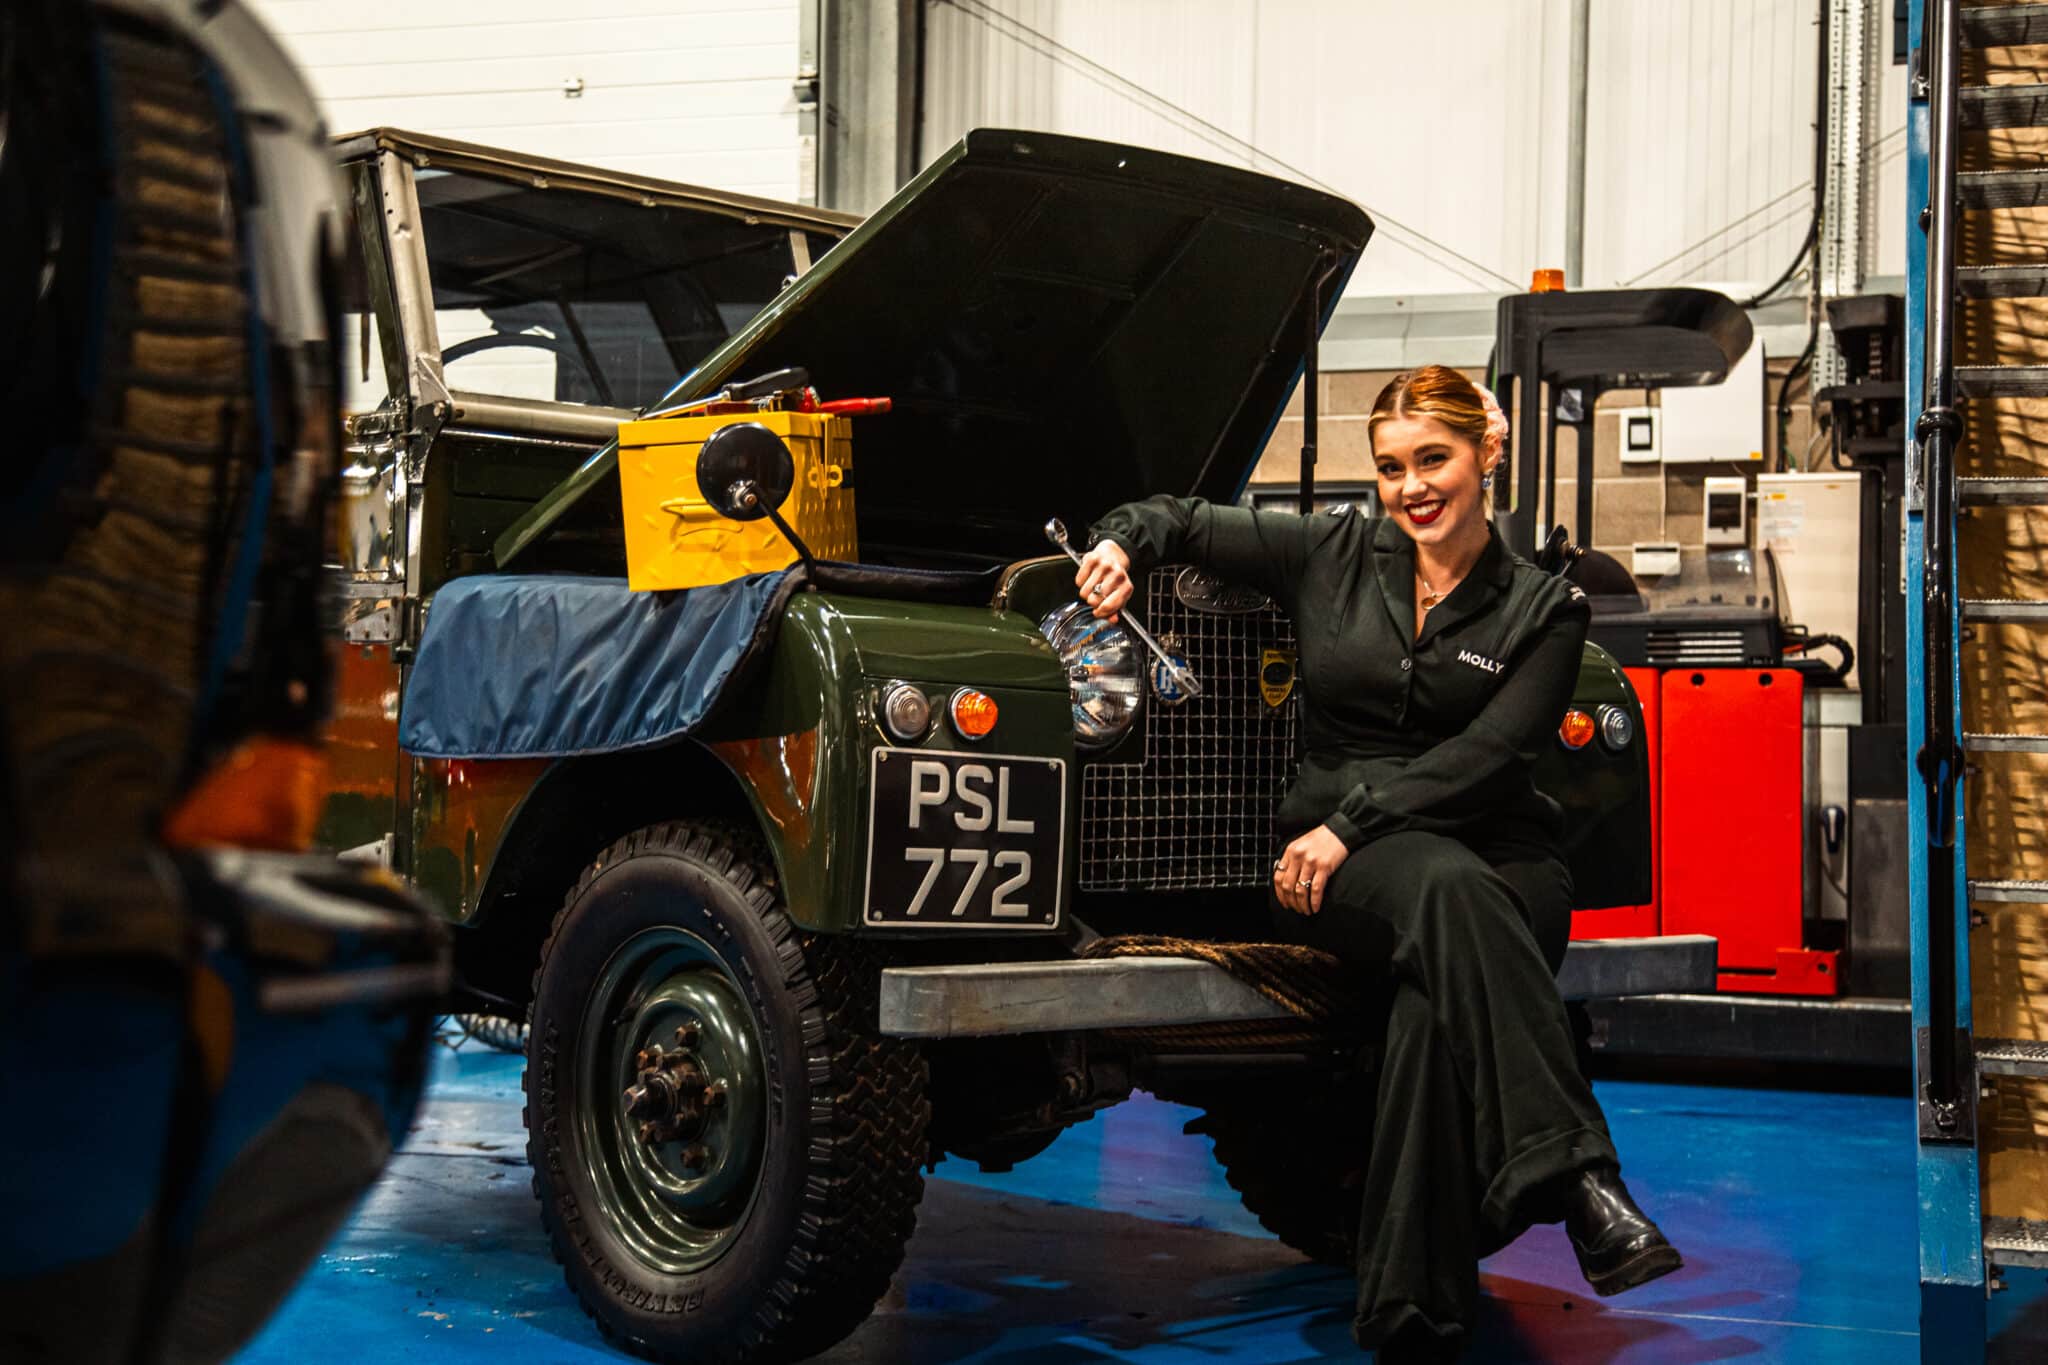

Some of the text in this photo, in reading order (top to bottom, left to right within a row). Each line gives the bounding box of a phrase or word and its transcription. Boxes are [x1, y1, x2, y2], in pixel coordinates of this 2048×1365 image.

[1457, 649, 1505, 674] MOLLY
[908, 760, 1035, 834] PSL
[905, 847, 1032, 918] 772
